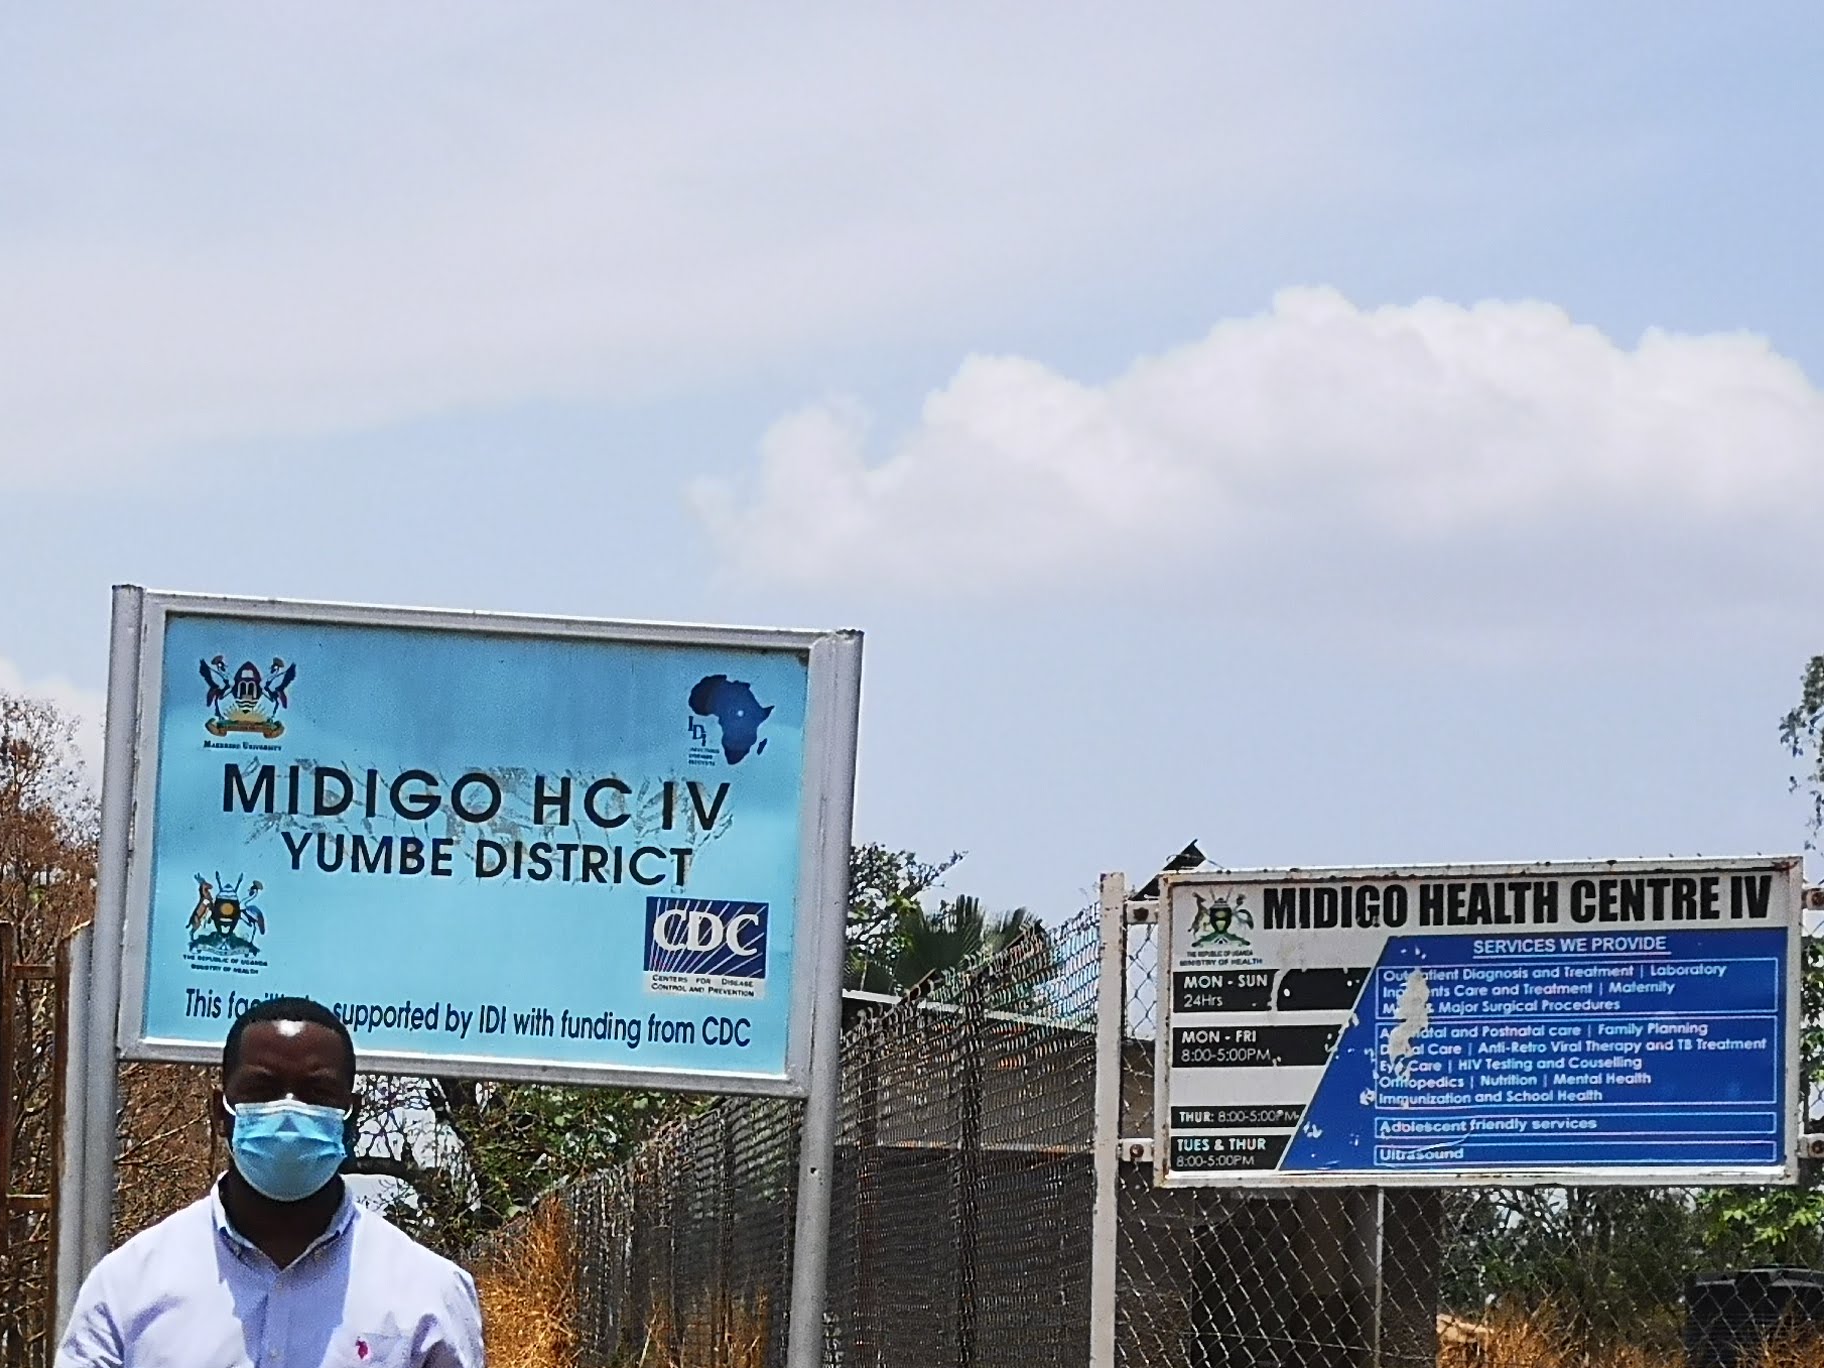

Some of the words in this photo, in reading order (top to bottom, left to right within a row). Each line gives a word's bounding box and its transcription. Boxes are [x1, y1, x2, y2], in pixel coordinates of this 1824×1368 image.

[223, 761, 501, 825] MIDIGO
[534, 774, 632, 832] HC
[662, 781, 732, 832] IV
[281, 831, 453, 876] YUMBE
[476, 839, 693, 886] DISTRICT
[1264, 884, 1407, 929] MIDIGO
[1420, 881, 1558, 926] HEALTH
[1575, 877, 1720, 923] CENTRE
[1731, 875, 1772, 919] IV
[654, 909, 759, 956] CDC
[1474, 939, 1555, 954] SERVICES
[1560, 938, 1587, 952] WE
[1592, 936, 1666, 951] PROVIDE
[1184, 976, 1222, 988] MON
[1238, 975, 1267, 987] SUN
[1184, 994, 1223, 1007] 24Hrs
[186, 989, 221, 1018] This
[333, 1000, 438, 1032] supported
[445, 1003, 473, 1039] by
[479, 1005, 506, 1034] IDI
[514, 1008, 554, 1037] with
[561, 1010, 641, 1049] funding
[648, 1013, 694, 1044] from
[702, 1016, 751, 1047] CDC
[1182, 1031, 1219, 1043] MON
[1236, 1030, 1256, 1042] FRI
[1428, 1043, 1461, 1055] Care
[1478, 1042, 1547, 1053] Anti-Retro
[1551, 1041, 1581, 1052] Viral
[1586, 1040, 1642, 1053] Therapy
[1646, 1039, 1673, 1050] and
[1678, 1039, 1692, 1050] TB
[1696, 1038, 1767, 1050] Treatment
[1181, 1048, 1270, 1062] 8:00-5:00PM
[1481, 1074, 1537, 1086] Nutrition
[1553, 1073, 1602, 1084] Mental
[1606, 1073, 1651, 1084] Health
[1475, 1091, 1502, 1102] and
[1507, 1090, 1553, 1102] School
[1558, 1090, 1602, 1101] Health
[1180, 1112, 1213, 1122] THUR:
[1380, 1121, 1467, 1133] Adolescent
[1470, 1119, 1527, 1132] friendly
[1532, 1118, 1597, 1129] services
[1177, 1139, 1209, 1151] TUES
[1214, 1139, 1224, 1150] &
[1229, 1138, 1266, 1150] THUR
[1177, 1155, 1254, 1167] 8:00-5:00PM
